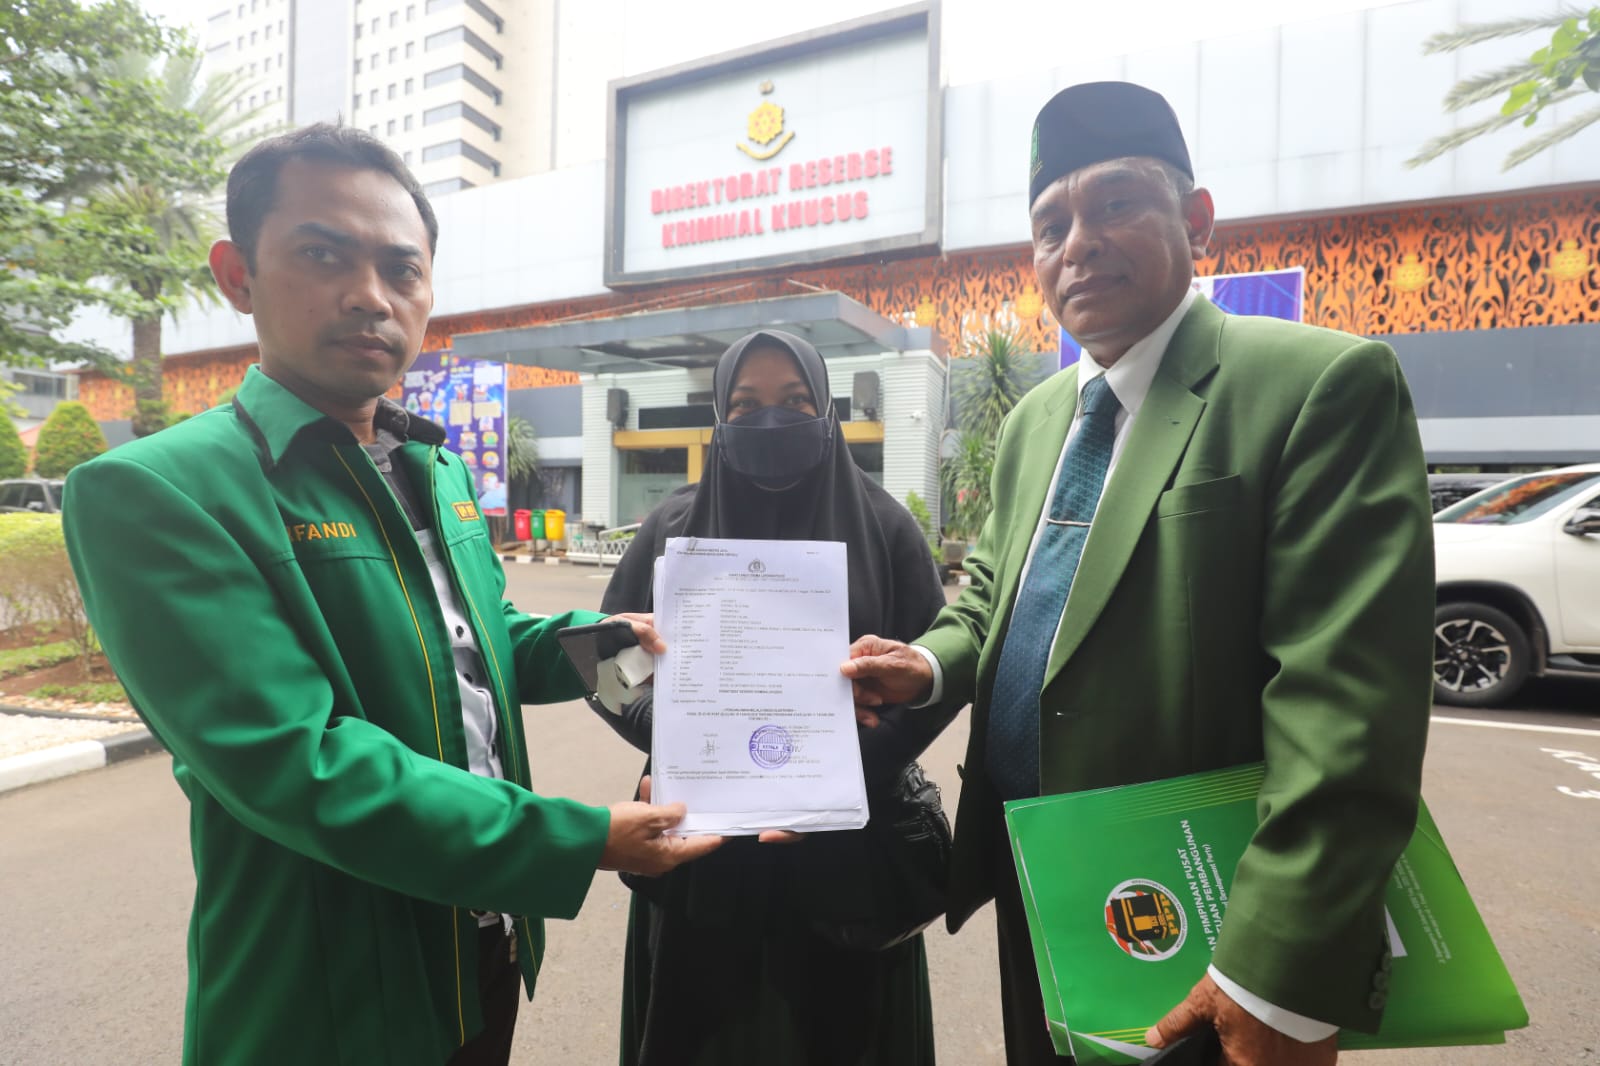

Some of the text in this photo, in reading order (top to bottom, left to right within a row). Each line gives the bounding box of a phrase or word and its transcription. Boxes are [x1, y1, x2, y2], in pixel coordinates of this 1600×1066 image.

[651, 146, 893, 215] DIREKTORAT RESERSE
[662, 191, 870, 249] KRIMINAL KHUSUS
[1177, 848, 1195, 880] PUSAT
[1180, 819, 1215, 902] PEMBANGUNAN
[1188, 881, 1213, 935] PIMPINAN
